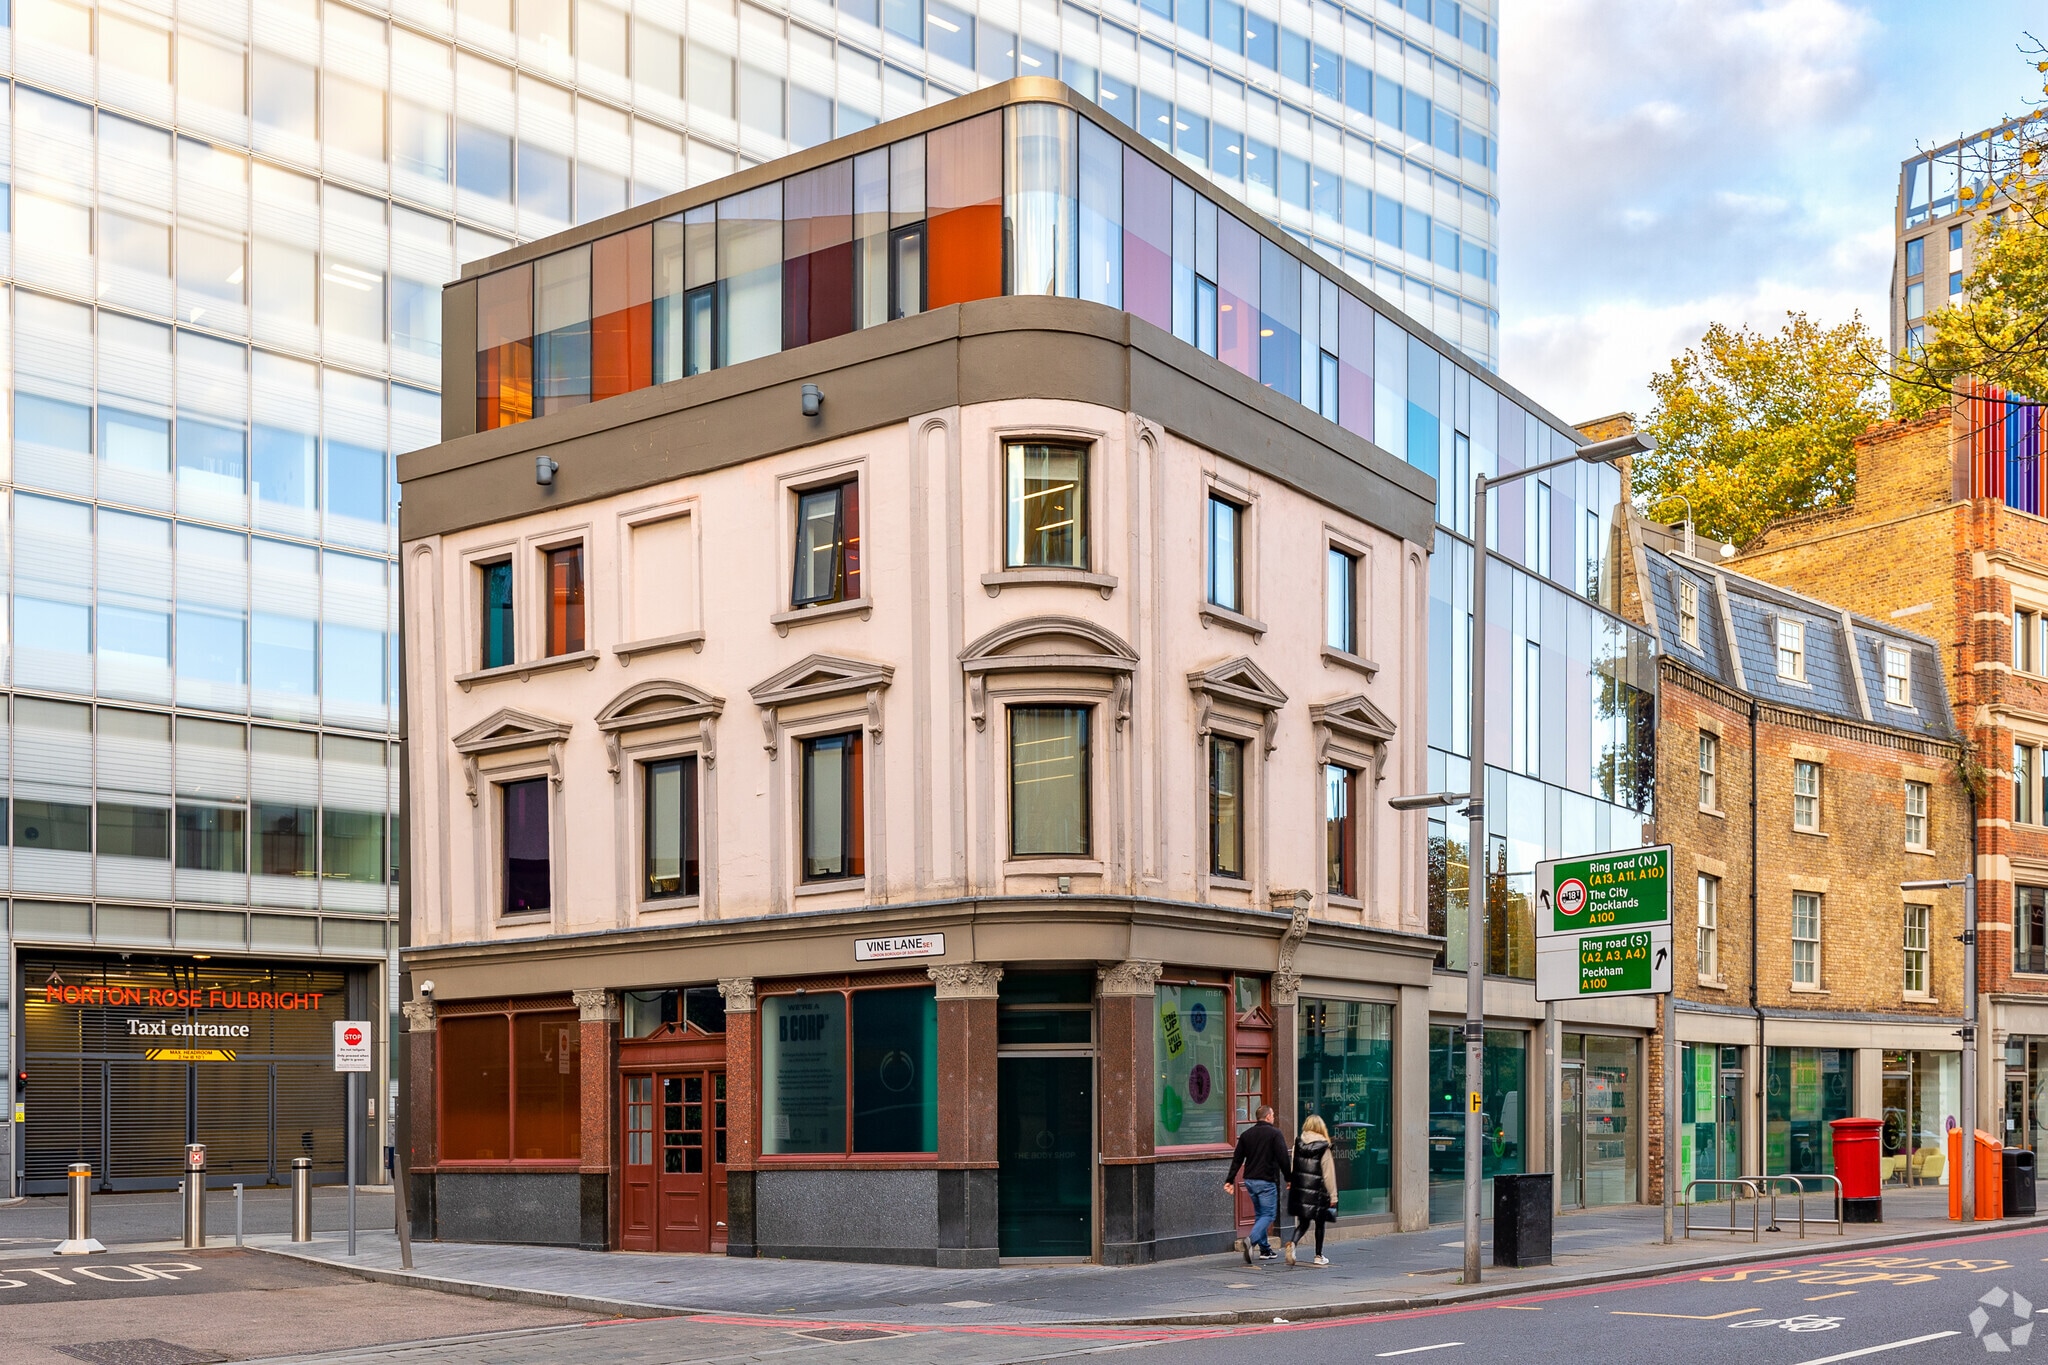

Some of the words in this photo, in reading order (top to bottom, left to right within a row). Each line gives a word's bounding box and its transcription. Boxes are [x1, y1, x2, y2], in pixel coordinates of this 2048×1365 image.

[1589, 863, 1611, 875] Ring
[1613, 858, 1635, 870] road
[1638, 854, 1658, 867] (N)
[1639, 866, 1665, 879] A10)
[1589, 890, 1606, 900] The
[1608, 887, 1628, 899] City
[1589, 898, 1639, 912] Docklands
[1589, 912, 1615, 924] A100
[866, 941, 891, 952] VINE
[893, 938, 922, 950] LANE
[1582, 940, 1603, 951] Ring
[1605, 937, 1627, 949] road
[1630, 934, 1649, 946] (S)
[1625, 947, 1646, 960] A4)
[1582, 967, 1624, 978] Peckham
[1581, 978, 1607, 990] A100
[46, 984, 141, 1006] NORTON
[149, 988, 203, 1008] ROSE
[209, 991, 324, 1010] FULBRIGHT
[787, 1003, 813, 1011] WE'RE
[126, 1019, 167, 1035] Taxi
[171, 1021, 250, 1037] entrance
[779, 1015, 788, 1041] B
[1164, 1019, 1178, 1032] UP
[1169, 1040, 1182, 1054] UP
[1328, 1069, 1345, 1082] Fuel
[1345, 1073, 1363, 1087] your
[1331, 1088, 1361, 1102] restless
[1334, 1127, 1345, 1139] Be
[1345, 1127, 1358, 1140] the
[1054, 1151, 1077, 1159] SHOP
[1819, 1256, 2008, 1271] BUS
[1699, 1269, 1941, 1286] STOP
